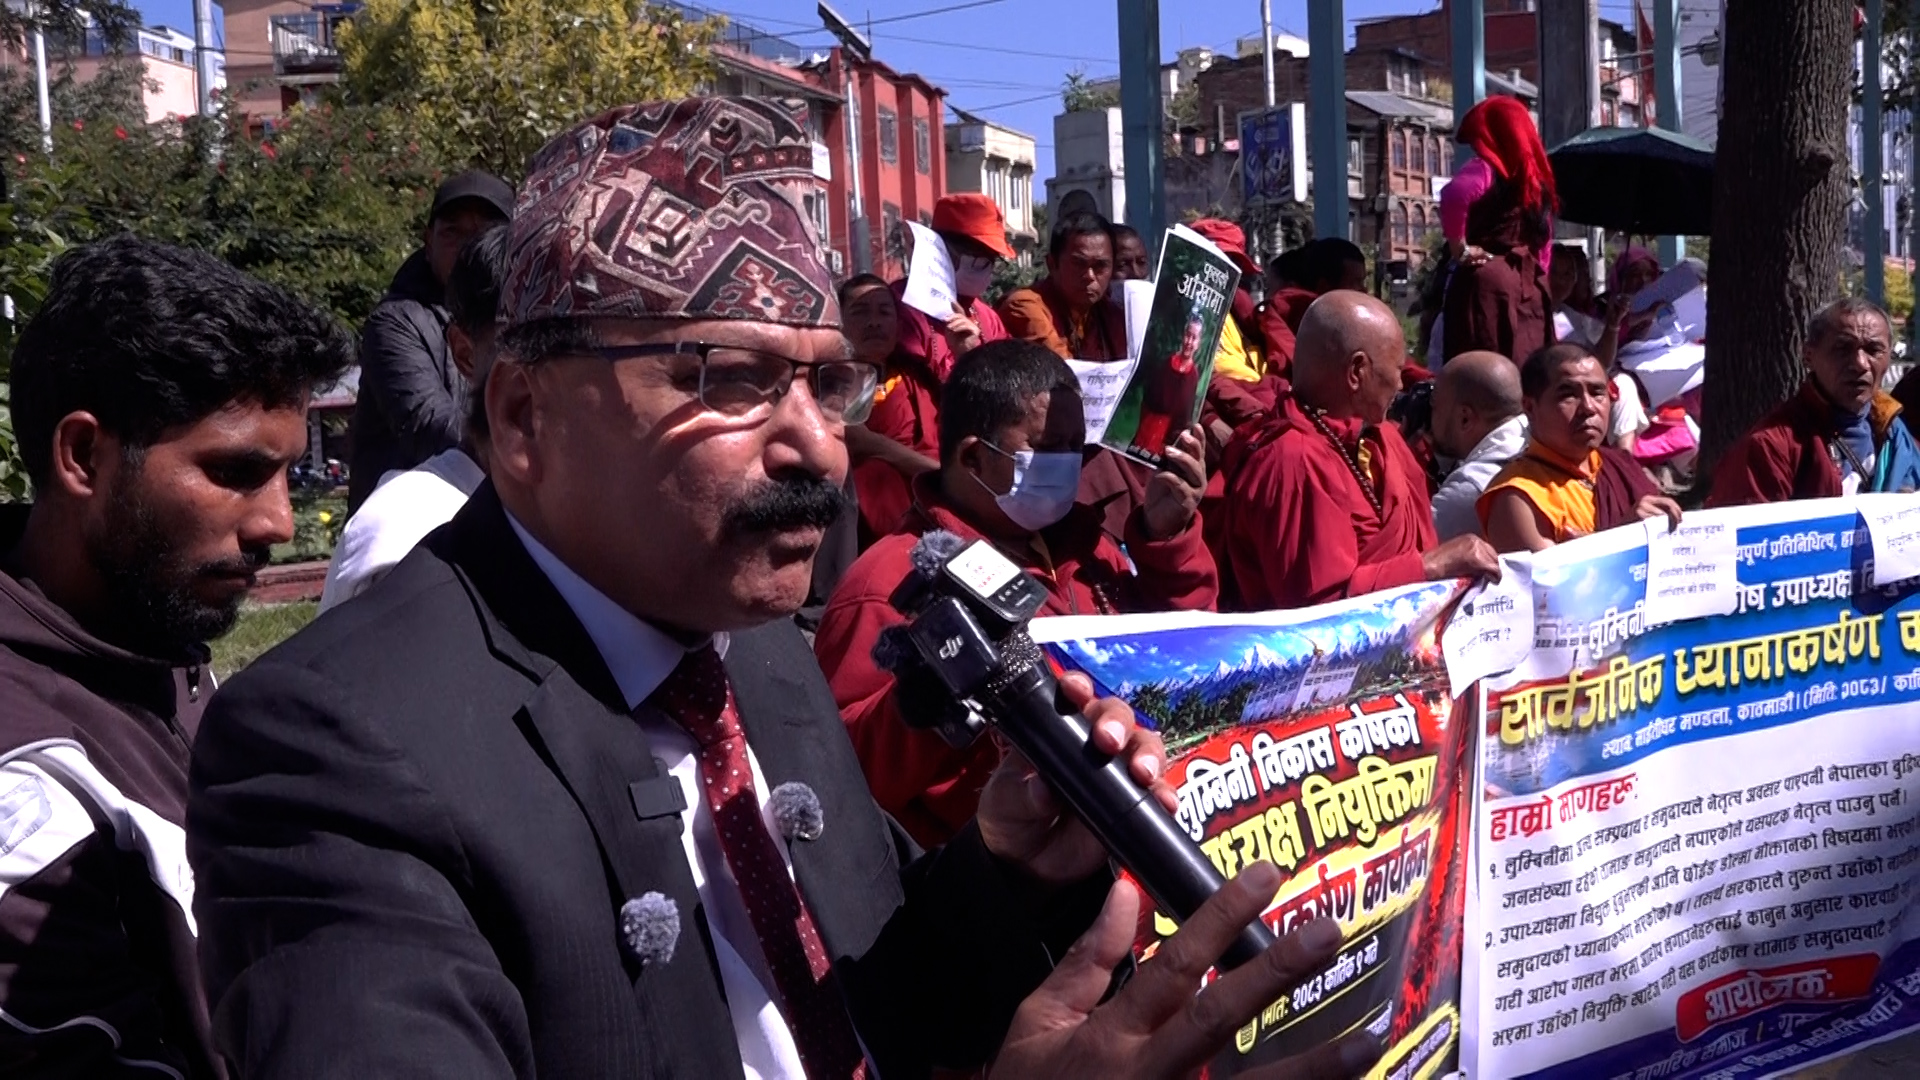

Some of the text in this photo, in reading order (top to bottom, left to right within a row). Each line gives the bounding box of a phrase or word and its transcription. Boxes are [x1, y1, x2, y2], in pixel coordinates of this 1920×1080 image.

[1771, 569, 1854, 608] उपाध्यक्ष
[1501, 655, 1665, 744] सार्वजनिक
[1674, 609, 1883, 694] ध्यानाकर्षण
[1175, 693, 1420, 842] लुम्बिनी विकास कोषको
[1301, 755, 1438, 843] नियुक्तिमा
[1491, 794, 1553, 841] हाम्रो
[1363, 825, 1431, 914] कार्यक्रम
[1502, 880, 1573, 909] जनसंख्या
[1634, 834, 1681, 867] समुदायले
[1745, 807, 1790, 832] यसपटक
[1793, 800, 1832, 824] नेतृत्व
[1836, 795, 1875, 816] पाउनु
[1505, 845, 1573, 879] लुम्बिनीमा
[1651, 796, 1704, 828] समुदायले
[1707, 790, 1743, 814] नेतृत्व
[1746, 780, 1782, 803] अवसर
[1828, 761, 1888, 781] नेपालका
[1497, 944, 1572, 980] समुदायको
[1725, 870, 1784, 899] सरकारले
[1500, 912, 1577, 944] उपाध्यक्षमा
[1822, 827, 1882, 848] विषयमा
[1293, 976, 1322, 1012] २०८३
[1324, 952, 1355, 990] कार्तिक
[1492, 1021, 1534, 1047] भएमा
[1581, 992, 1629, 1023] नियुक्ति
[1678, 959, 1696, 980] यस
[1698, 943, 1749, 972] कार्यकाल
[1495, 987, 1523, 1012] गरी
[1527, 980, 1569, 1005] आरोप
[1571, 969, 1608, 991] गलत
[1746, 905, 1787, 928] कानुन
[1790, 895, 1843, 921] अनुसार
[1704, 967, 1835, 1021] आयोजक:
[1700, 1027, 1750, 1061] समाज
